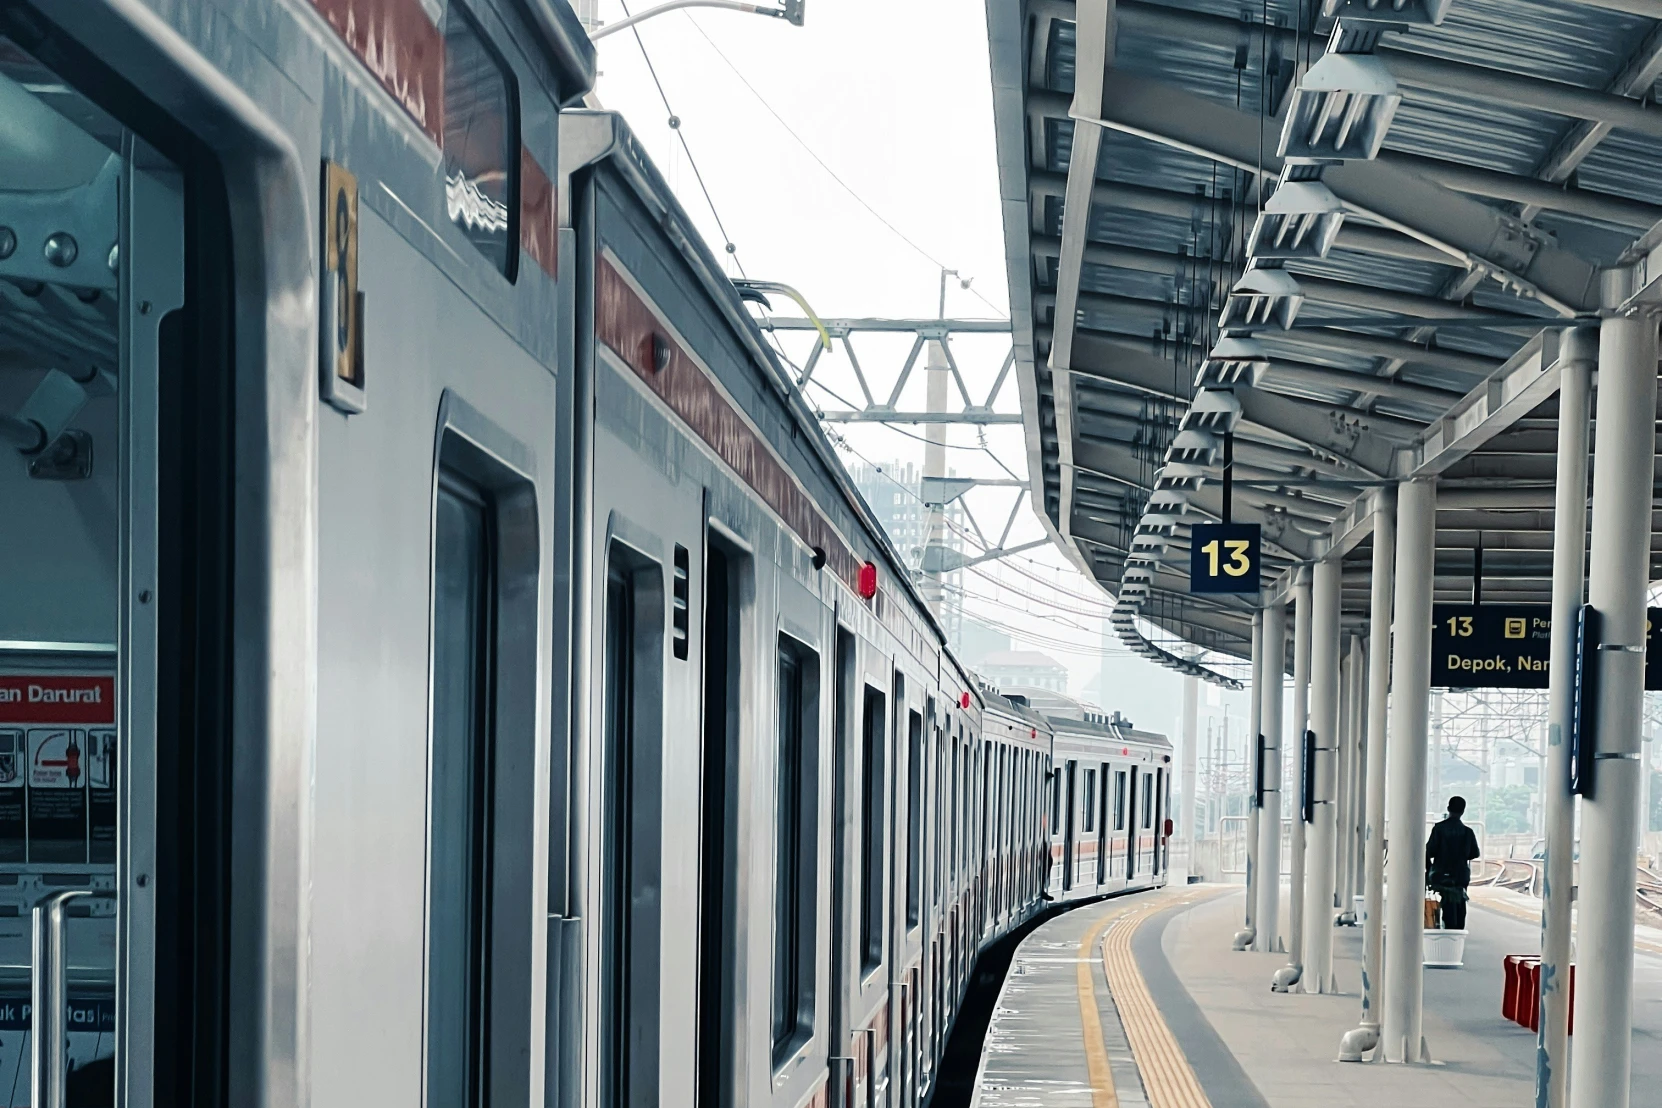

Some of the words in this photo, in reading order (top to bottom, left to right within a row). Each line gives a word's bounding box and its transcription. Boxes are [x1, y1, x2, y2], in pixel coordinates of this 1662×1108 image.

[336, 187, 350, 352] 8
[1201, 539, 1250, 577] 13
[1446, 616, 1474, 637] 13
[1447, 654, 1512, 674] Depok,
[28, 684, 101, 703] Darurat
